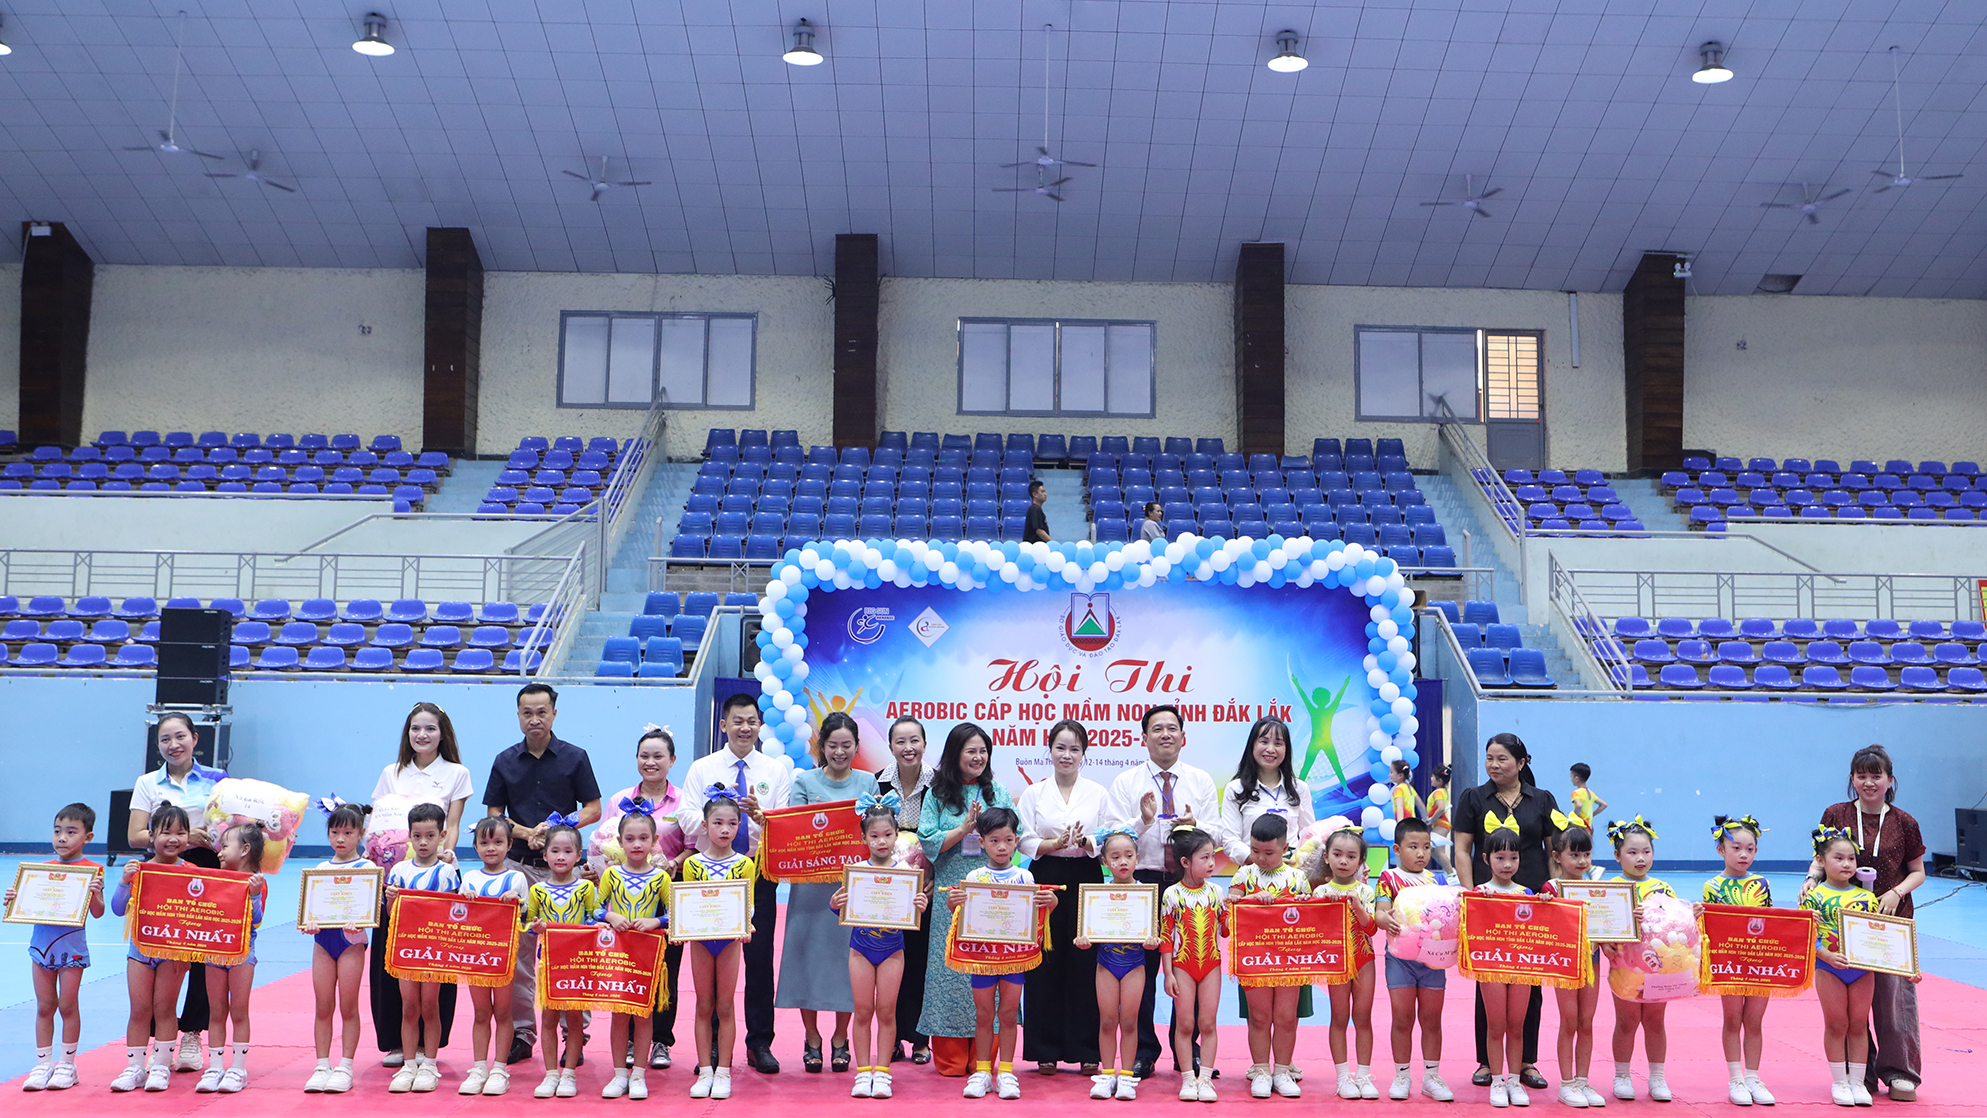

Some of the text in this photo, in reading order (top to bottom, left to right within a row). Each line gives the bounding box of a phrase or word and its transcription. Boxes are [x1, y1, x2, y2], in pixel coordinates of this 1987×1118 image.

[987, 658, 1195, 699] Hội Thi
[974, 696, 1012, 720] CẤP
[1019, 703, 1056, 725] HỌC
[1063, 697, 1110, 721] MẦM
[1213, 698, 1250, 722] ĐẮK
[992, 724, 1036, 746] NĂM
[1016, 757, 1032, 765] Buôn
[1105, 759, 1123, 768] tháng
[818, 834, 853, 843] AEROBIC
[779, 858, 803, 869] GIẢI
[806, 856, 836, 867] SÁNG
[190, 907, 224, 915] AEROBIC
[142, 924, 235, 943] GIẢI NHẤT
[451, 931, 491, 939] AEROBIC
[1520, 931, 1558, 940] AEROBIC
[400, 947, 502, 966] GIẢI NHẤT
[600, 958, 636, 967] AEROBIC
[1242, 950, 1338, 966] GIẢI NHẤT
[1470, 948, 1512, 962] GIẢI
[1518, 953, 1571, 967] NHẤT
[1710, 961, 1800, 978] GIẢI NHẤT
[556, 976, 646, 995] GIẢI NHẤT
